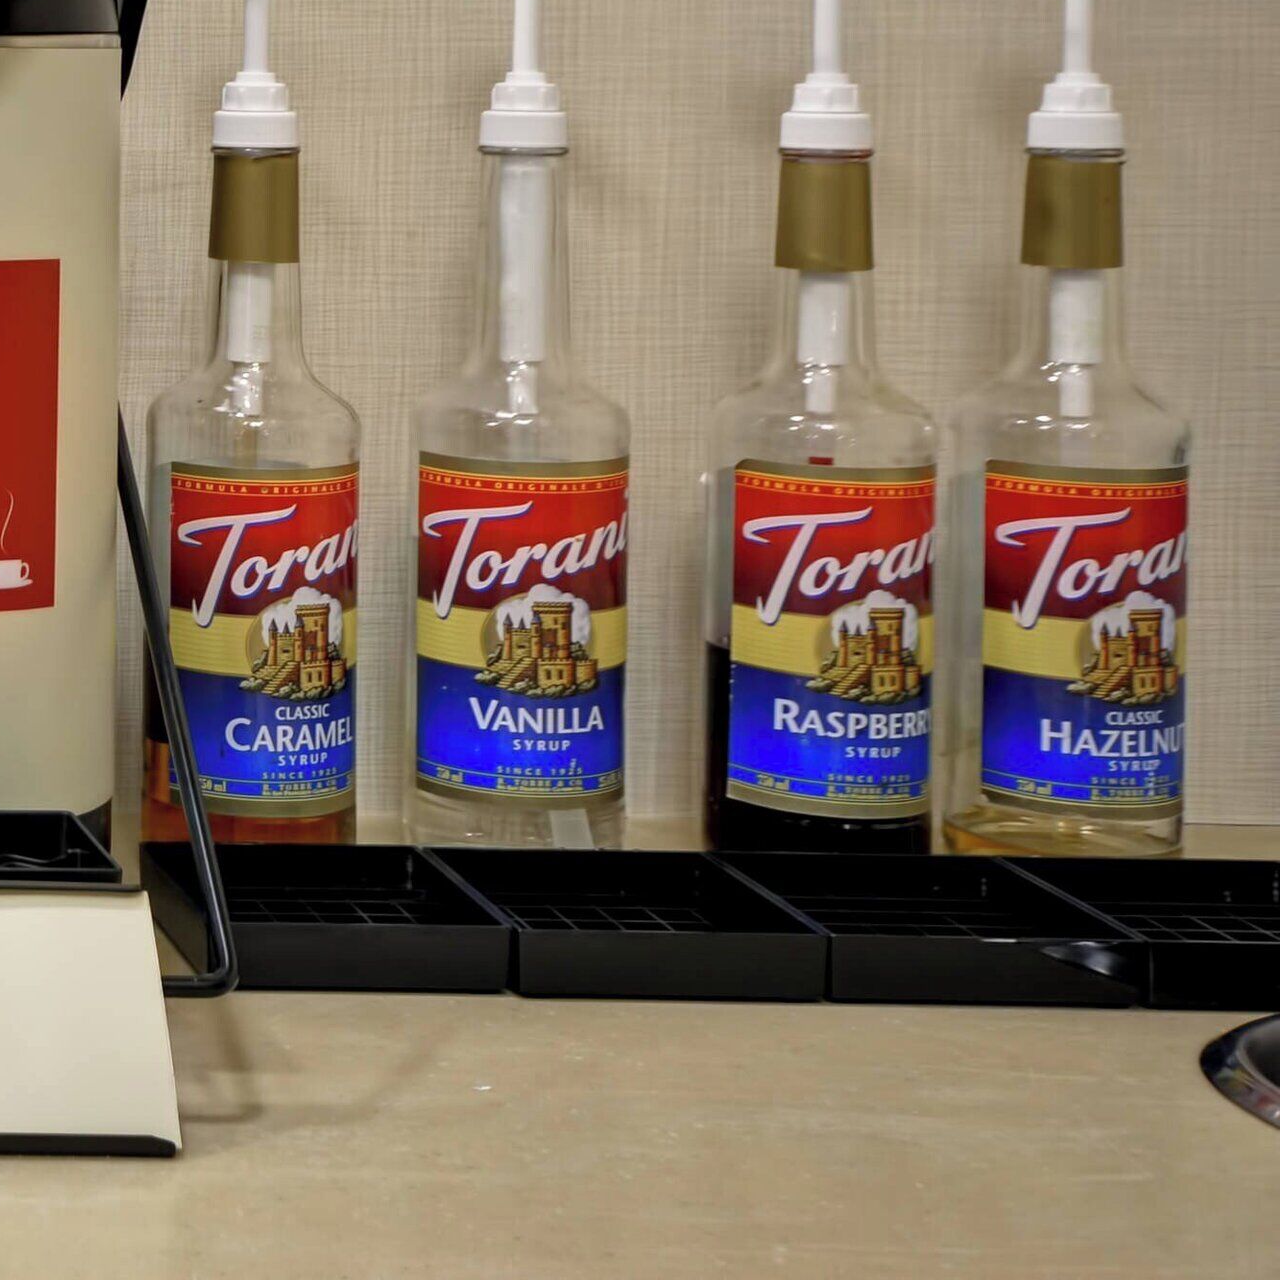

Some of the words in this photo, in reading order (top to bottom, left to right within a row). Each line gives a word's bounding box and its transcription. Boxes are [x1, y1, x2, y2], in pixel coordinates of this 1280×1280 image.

[275, 703, 331, 721] CLASSIC
[468, 696, 605, 734] VANILLA
[772, 697, 933, 740] RASPBERR
[1104, 709, 1164, 726] CLASSIC
[224, 716, 353, 753] CARAMEL
[512, 739, 572, 752] SYRUP
[844, 746, 902, 759] SYRUP
[277, 752, 328, 767] SYRUP
[1108, 759, 1162, 772] SYRUP
